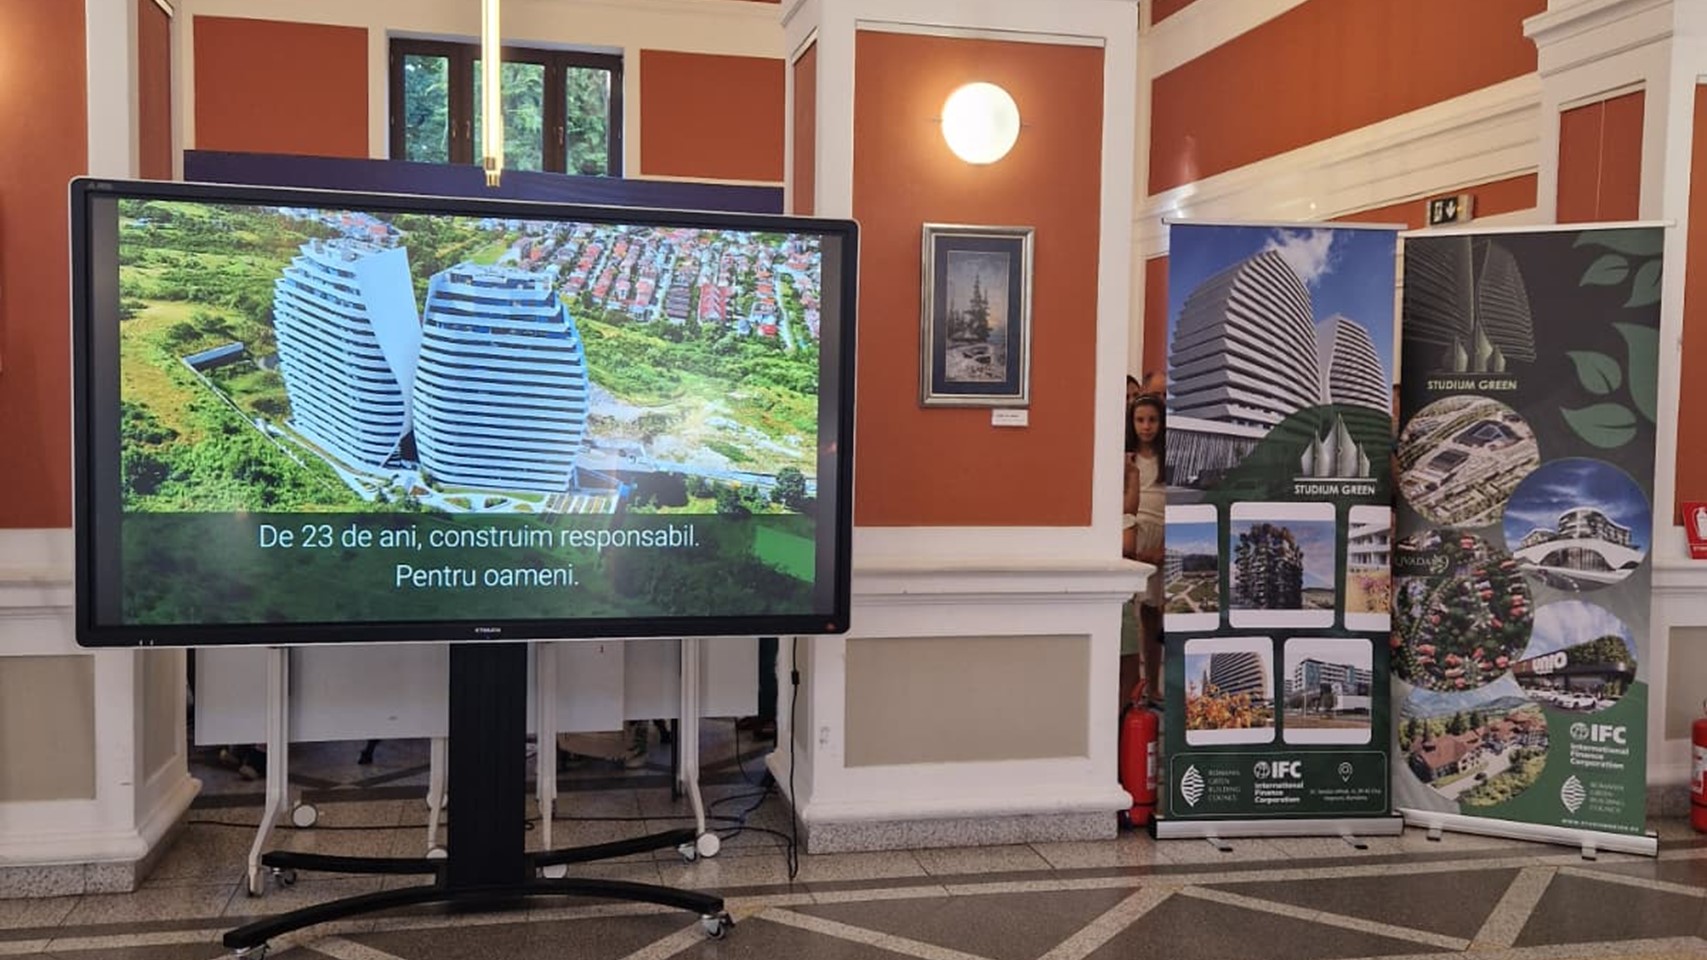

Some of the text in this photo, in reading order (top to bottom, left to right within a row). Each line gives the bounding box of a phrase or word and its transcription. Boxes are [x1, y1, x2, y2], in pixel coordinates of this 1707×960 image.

[1427, 380, 1517, 390] STUDIUM GREEN
[1294, 484, 1376, 495] STUDIUM GREEN
[259, 523, 700, 551] De 23 de ani, construim responsabil.
[396, 563, 579, 587] Pentru oameni.
[1591, 724, 1627, 744] IFC
[1570, 743, 1629, 755] International
[1570, 751, 1604, 760] Finance
[1570, 758, 1624, 769] Corporation
[1272, 761, 1302, 778] IFC
[1254, 780, 1304, 789] International
[1254, 796, 1301, 805] Corporation
